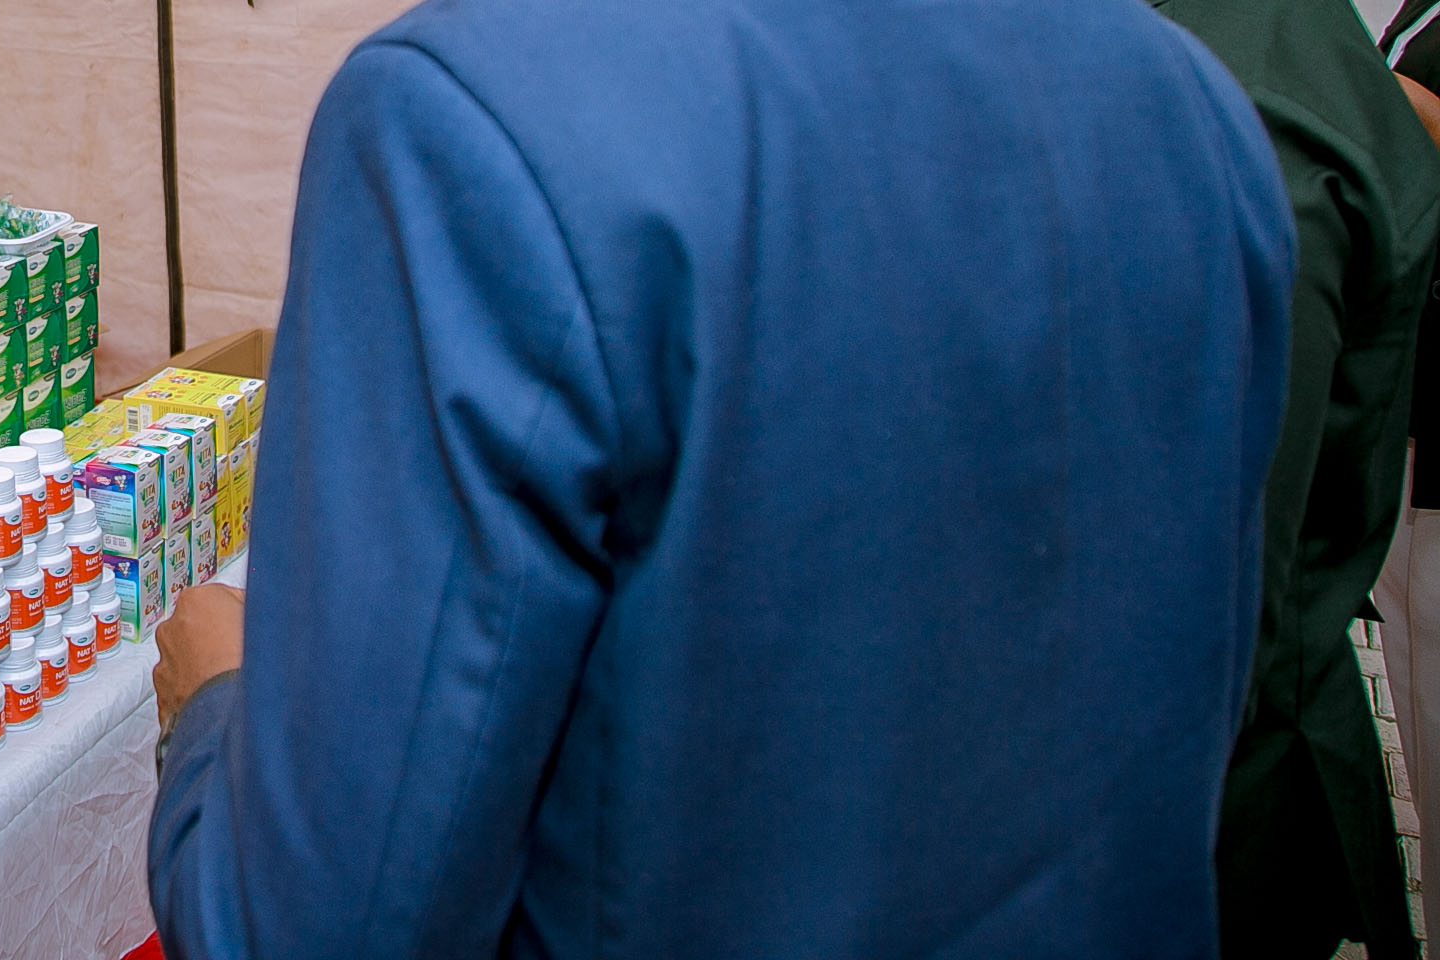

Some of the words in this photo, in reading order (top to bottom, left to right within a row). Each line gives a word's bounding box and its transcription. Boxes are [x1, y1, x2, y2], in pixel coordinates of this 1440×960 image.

[139, 485, 156, 503] VITA
[86, 558, 98, 566] NAT
[55, 581, 68, 589] NAT
[28, 602, 41, 610] NAT
[104, 627, 116, 635] NAT
[77, 650, 90, 658] NAT
[19, 697, 34, 706] NAT
